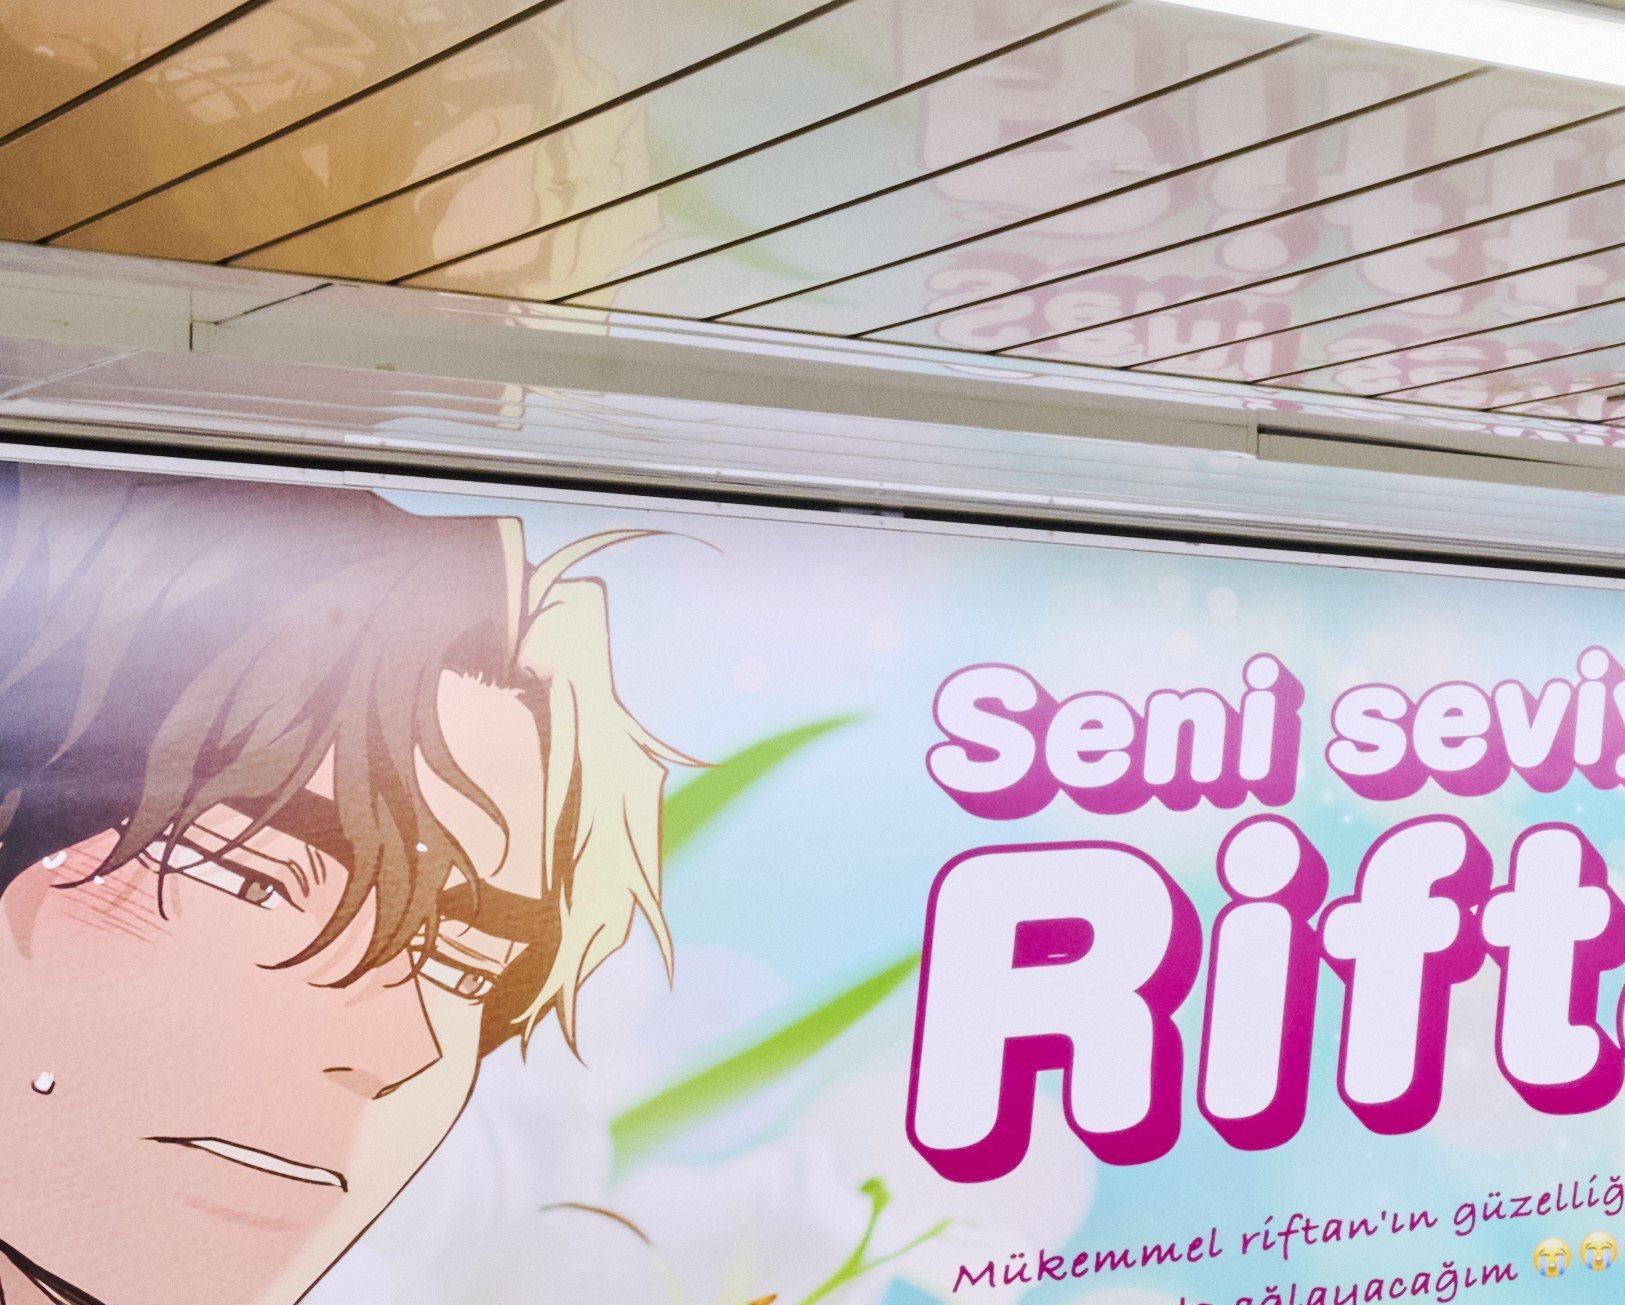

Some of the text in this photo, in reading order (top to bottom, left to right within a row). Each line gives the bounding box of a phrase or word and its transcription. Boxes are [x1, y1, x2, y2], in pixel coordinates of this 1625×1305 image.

[926, 652, 1305, 819] Seni
[952, 1227, 1222, 1292] Mükemmel
[1241, 1210, 1438, 1260] riftan'ın
